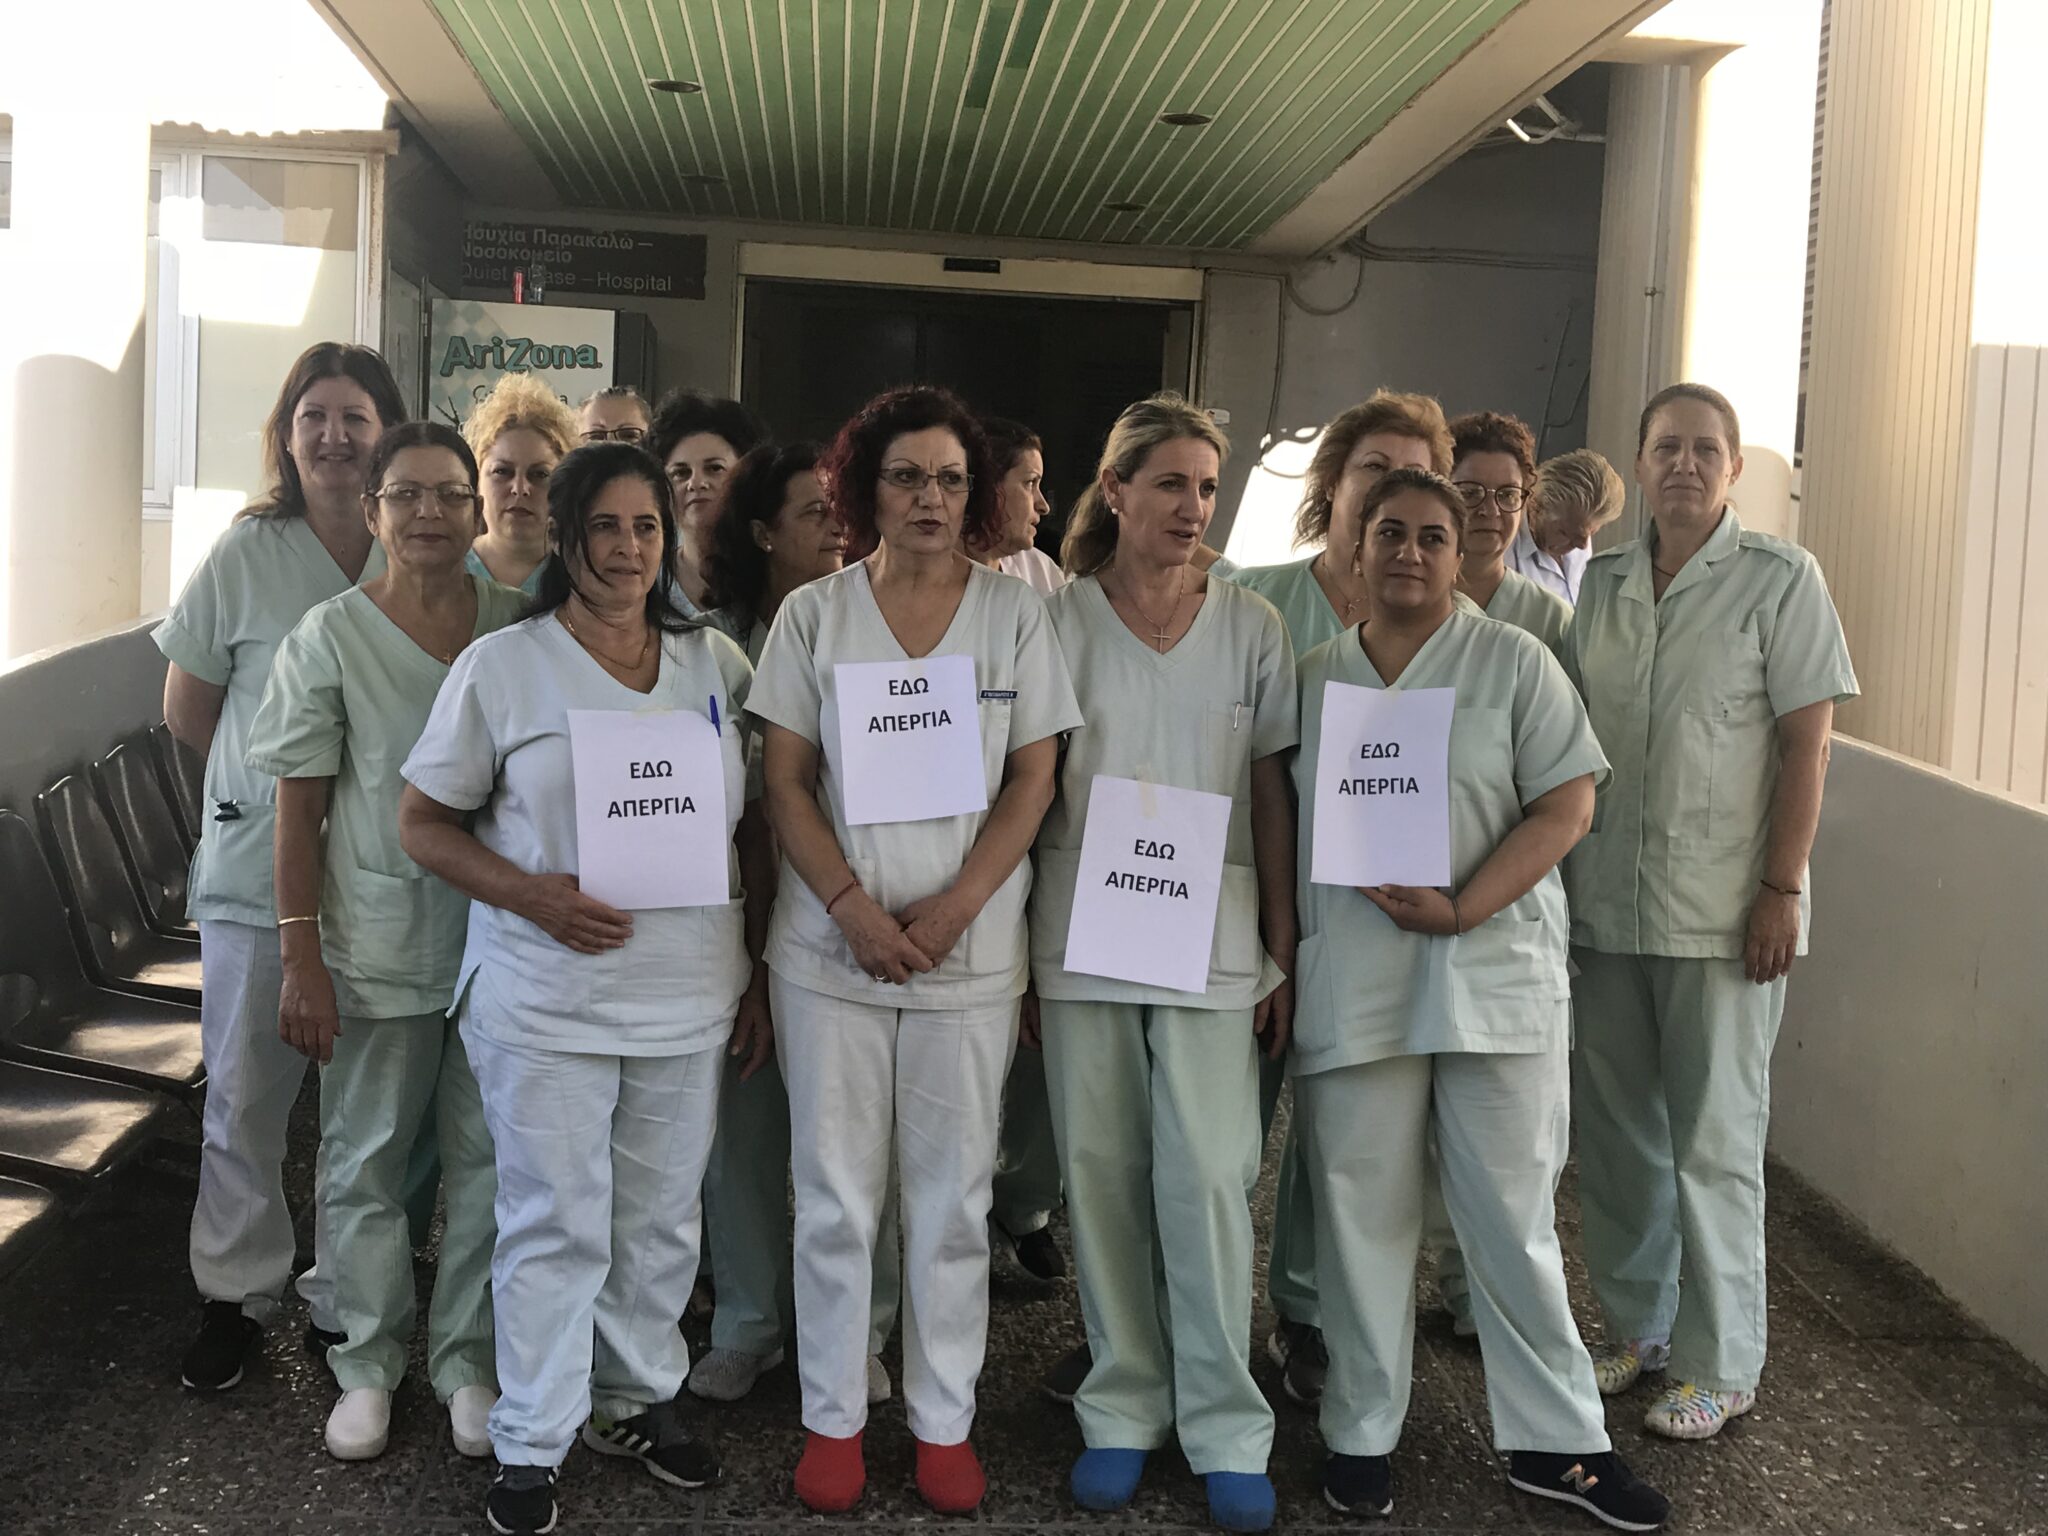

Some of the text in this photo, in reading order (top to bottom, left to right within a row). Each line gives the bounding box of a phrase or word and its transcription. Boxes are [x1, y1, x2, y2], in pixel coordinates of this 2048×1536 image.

[533, 228, 634, 249] Παρακαλώ
[597, 272, 672, 293] Hospital
[889, 677, 928, 696] ΕΔΩ
[869, 710, 952, 734] ΑΠΕΡΓΙΑ
[1361, 741, 1400, 760] ΕΔΩ
[629, 760, 673, 779] ΕΔΩ
[1338, 776, 1420, 796] ΑΠΕΡΓΙΑ
[607, 796, 696, 819] ΑΠΕΡΓΙΑ
[1134, 838, 1176, 861] ΕΔΩ
[1105, 870, 1189, 900] ΑΠΕΡΓΙΑ
